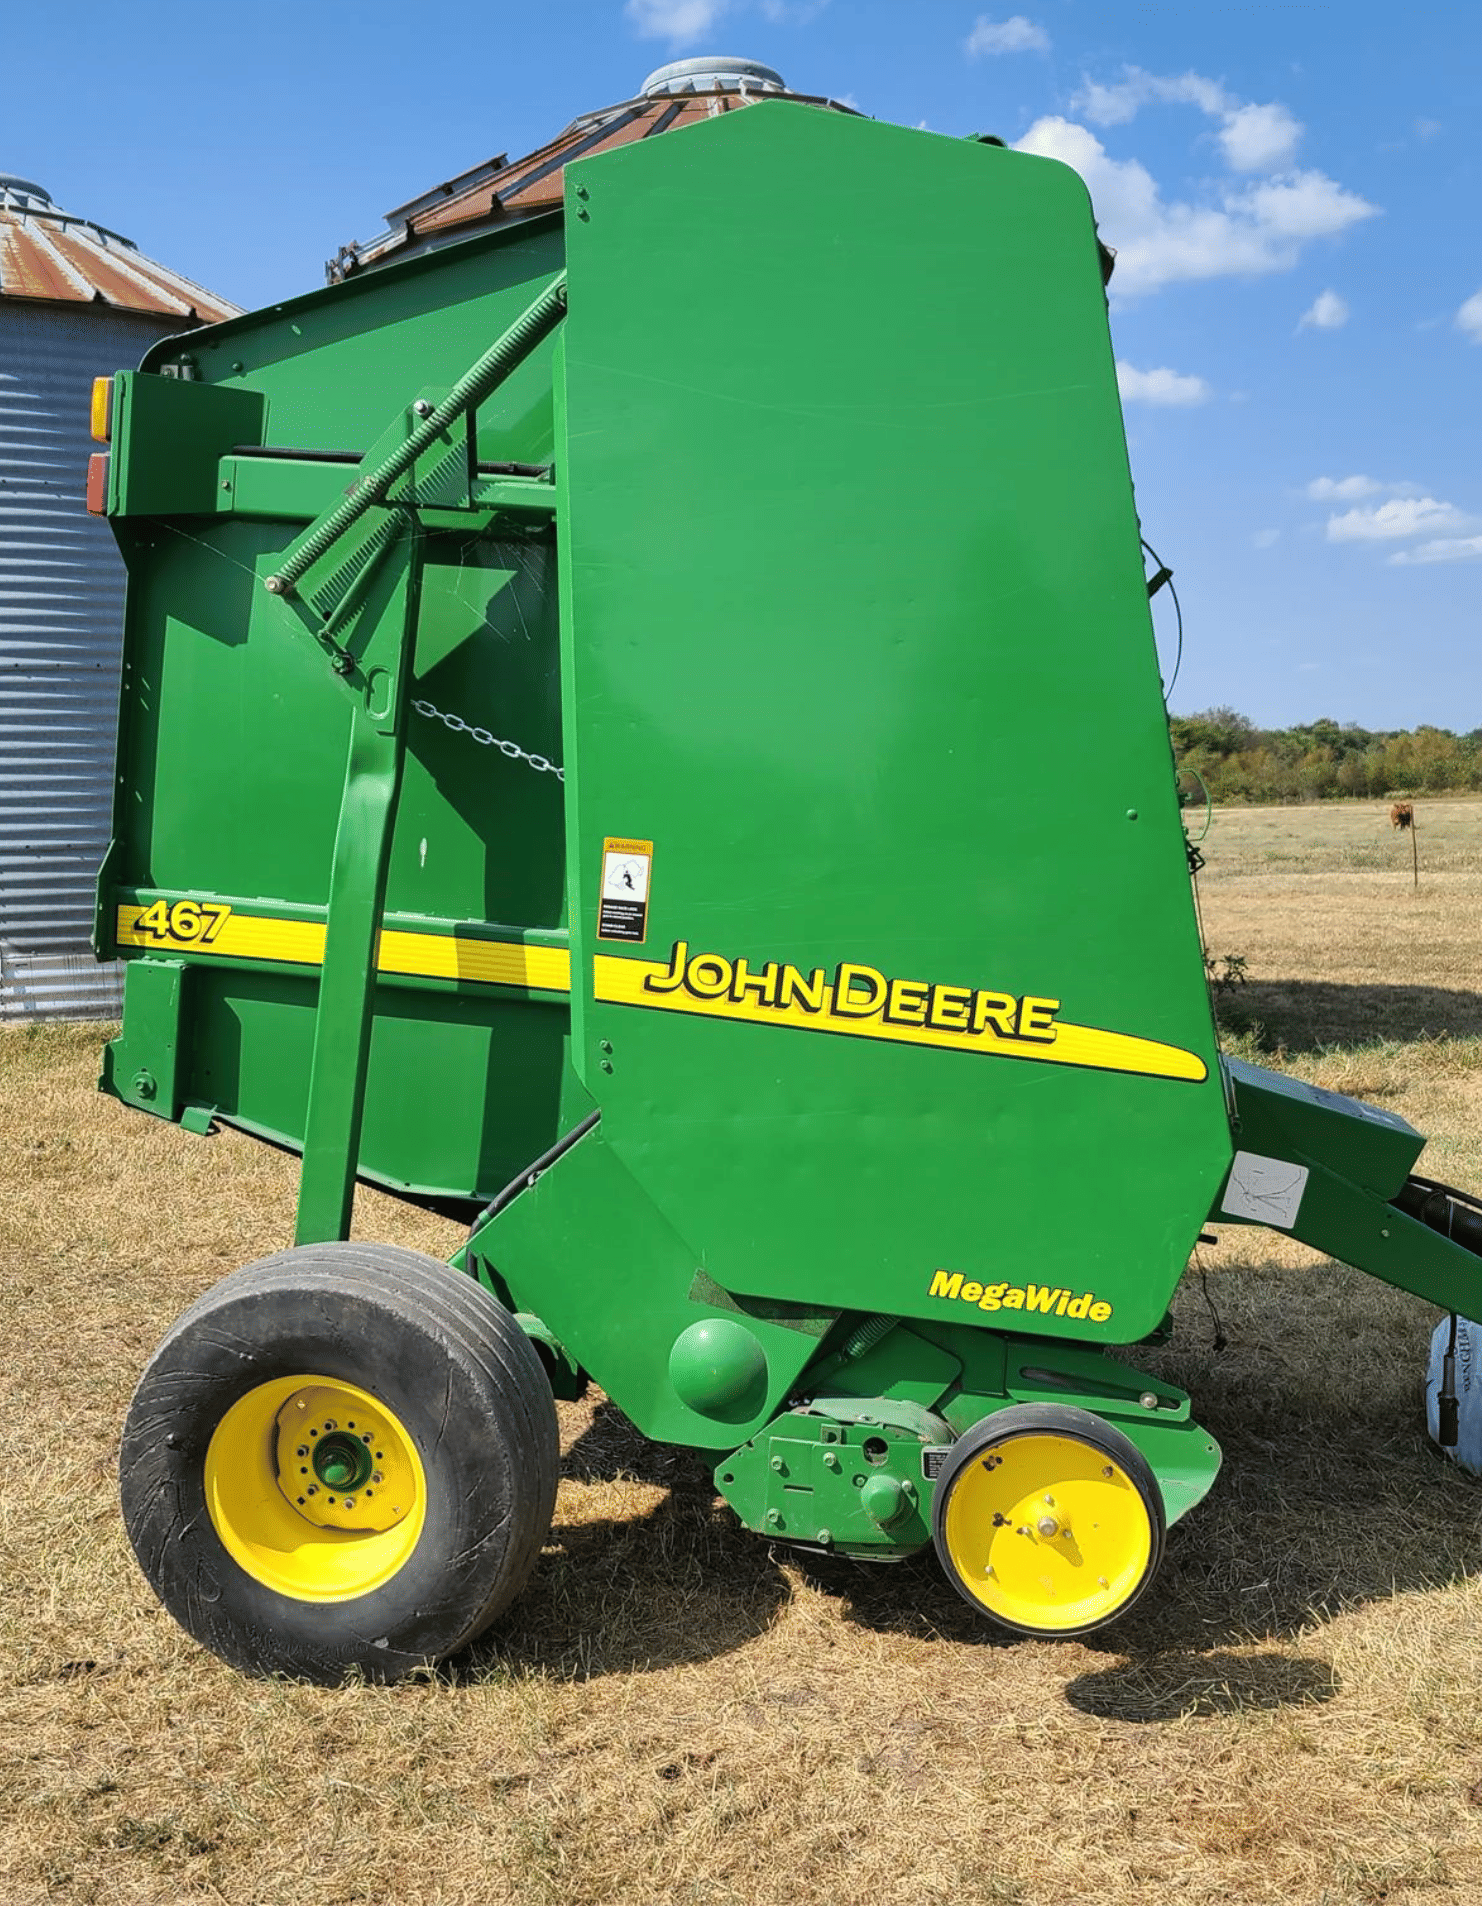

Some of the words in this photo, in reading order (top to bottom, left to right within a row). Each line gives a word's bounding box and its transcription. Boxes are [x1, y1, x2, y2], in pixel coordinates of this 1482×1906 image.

[134, 899, 232, 943] 467
[644, 941, 825, 1013] JOHN
[831, 962, 1061, 1045] DEERE
[928, 1269, 1114, 1323] MegaWide
